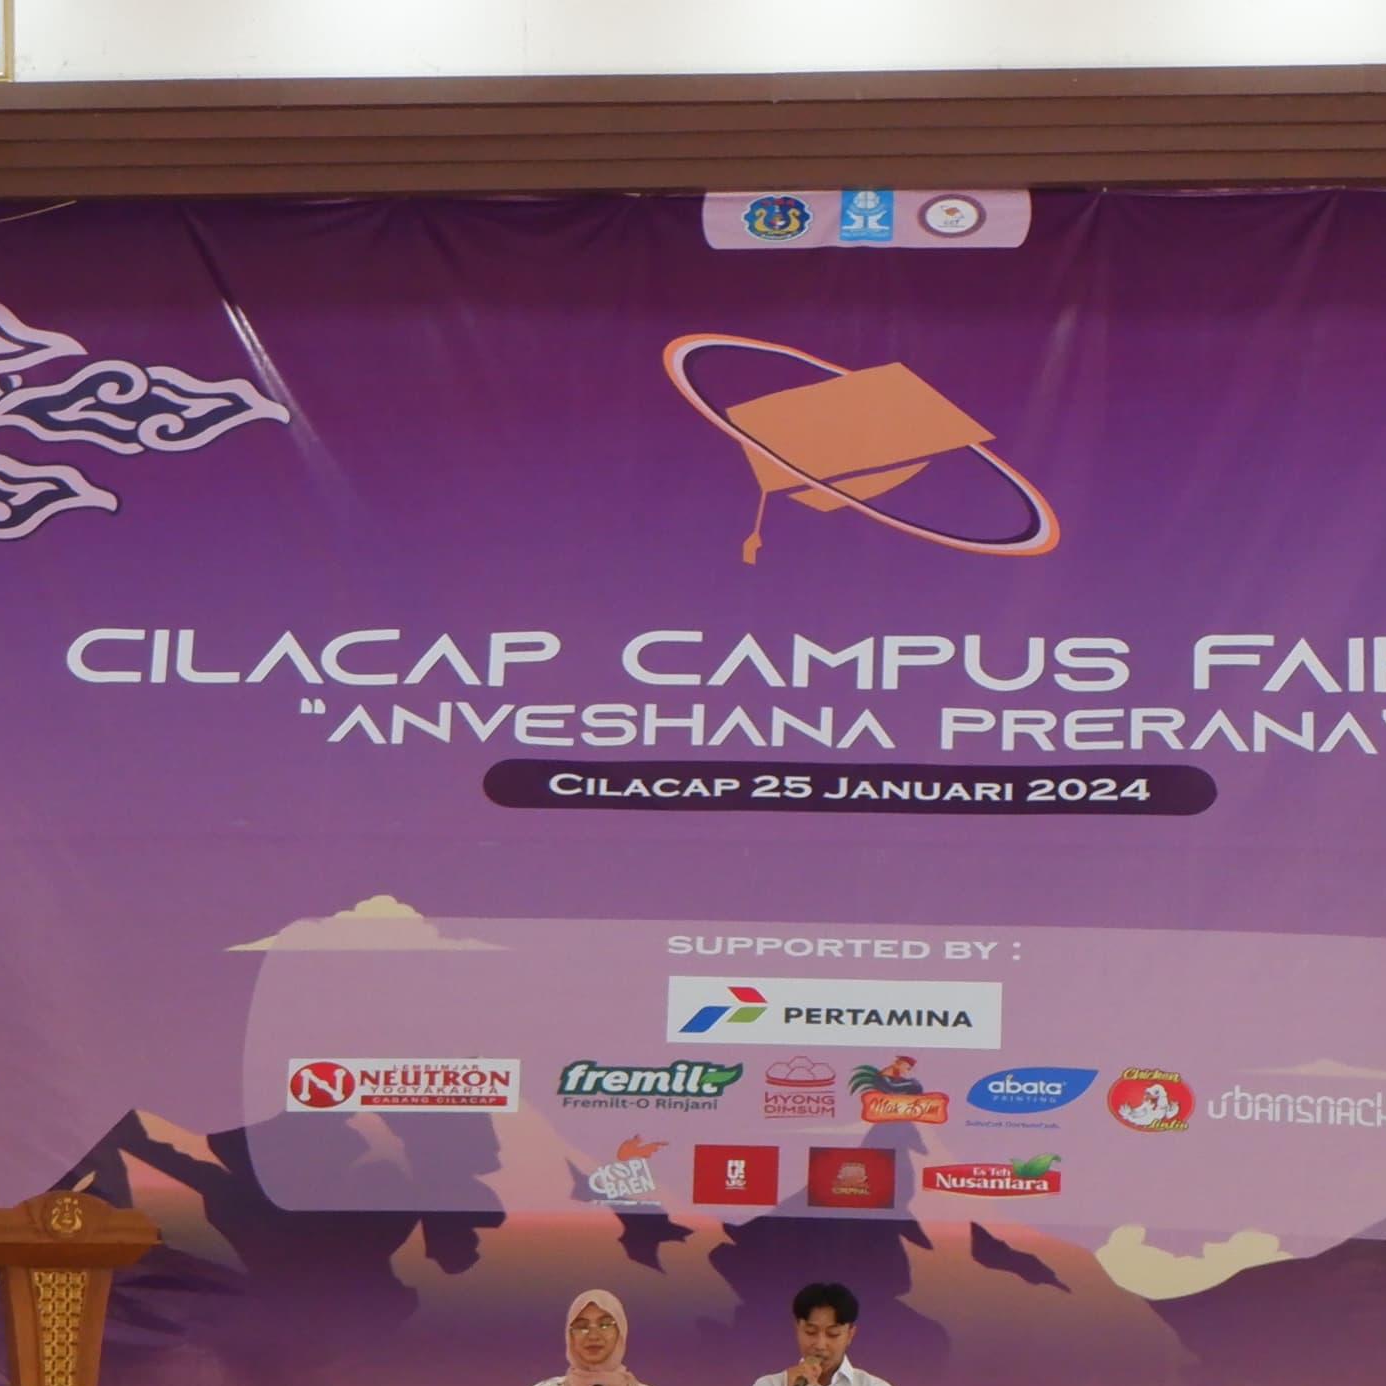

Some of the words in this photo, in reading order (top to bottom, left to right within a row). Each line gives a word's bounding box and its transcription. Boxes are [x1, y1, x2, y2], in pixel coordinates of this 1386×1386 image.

[66, 627, 562, 687] CILACAP
[621, 630, 1131, 693] CAMPUS
[750, 775, 813, 798] 25
[1026, 778, 1151, 802] 2024
[667, 935, 931, 960] SUPPORTED
[944, 941, 999, 961] BY
[783, 1006, 974, 1029] PERTAMINA
[359, 1069, 511, 1087] NEUTRON
[987, 1074, 1063, 1095] abata
[370, 1085, 500, 1095] YOGYAKARTA
[372, 1096, 430, 1104] CABANG
[562, 1096, 650, 1110] Fremilt-O
[655, 1097, 718, 1113] Rinjani
[764, 1104, 835, 1117] DIMSUM
[972, 1167, 987, 1177] Es
[989, 1167, 1012, 1177] Teh
[934, 1172, 1049, 1192] Nusantara
